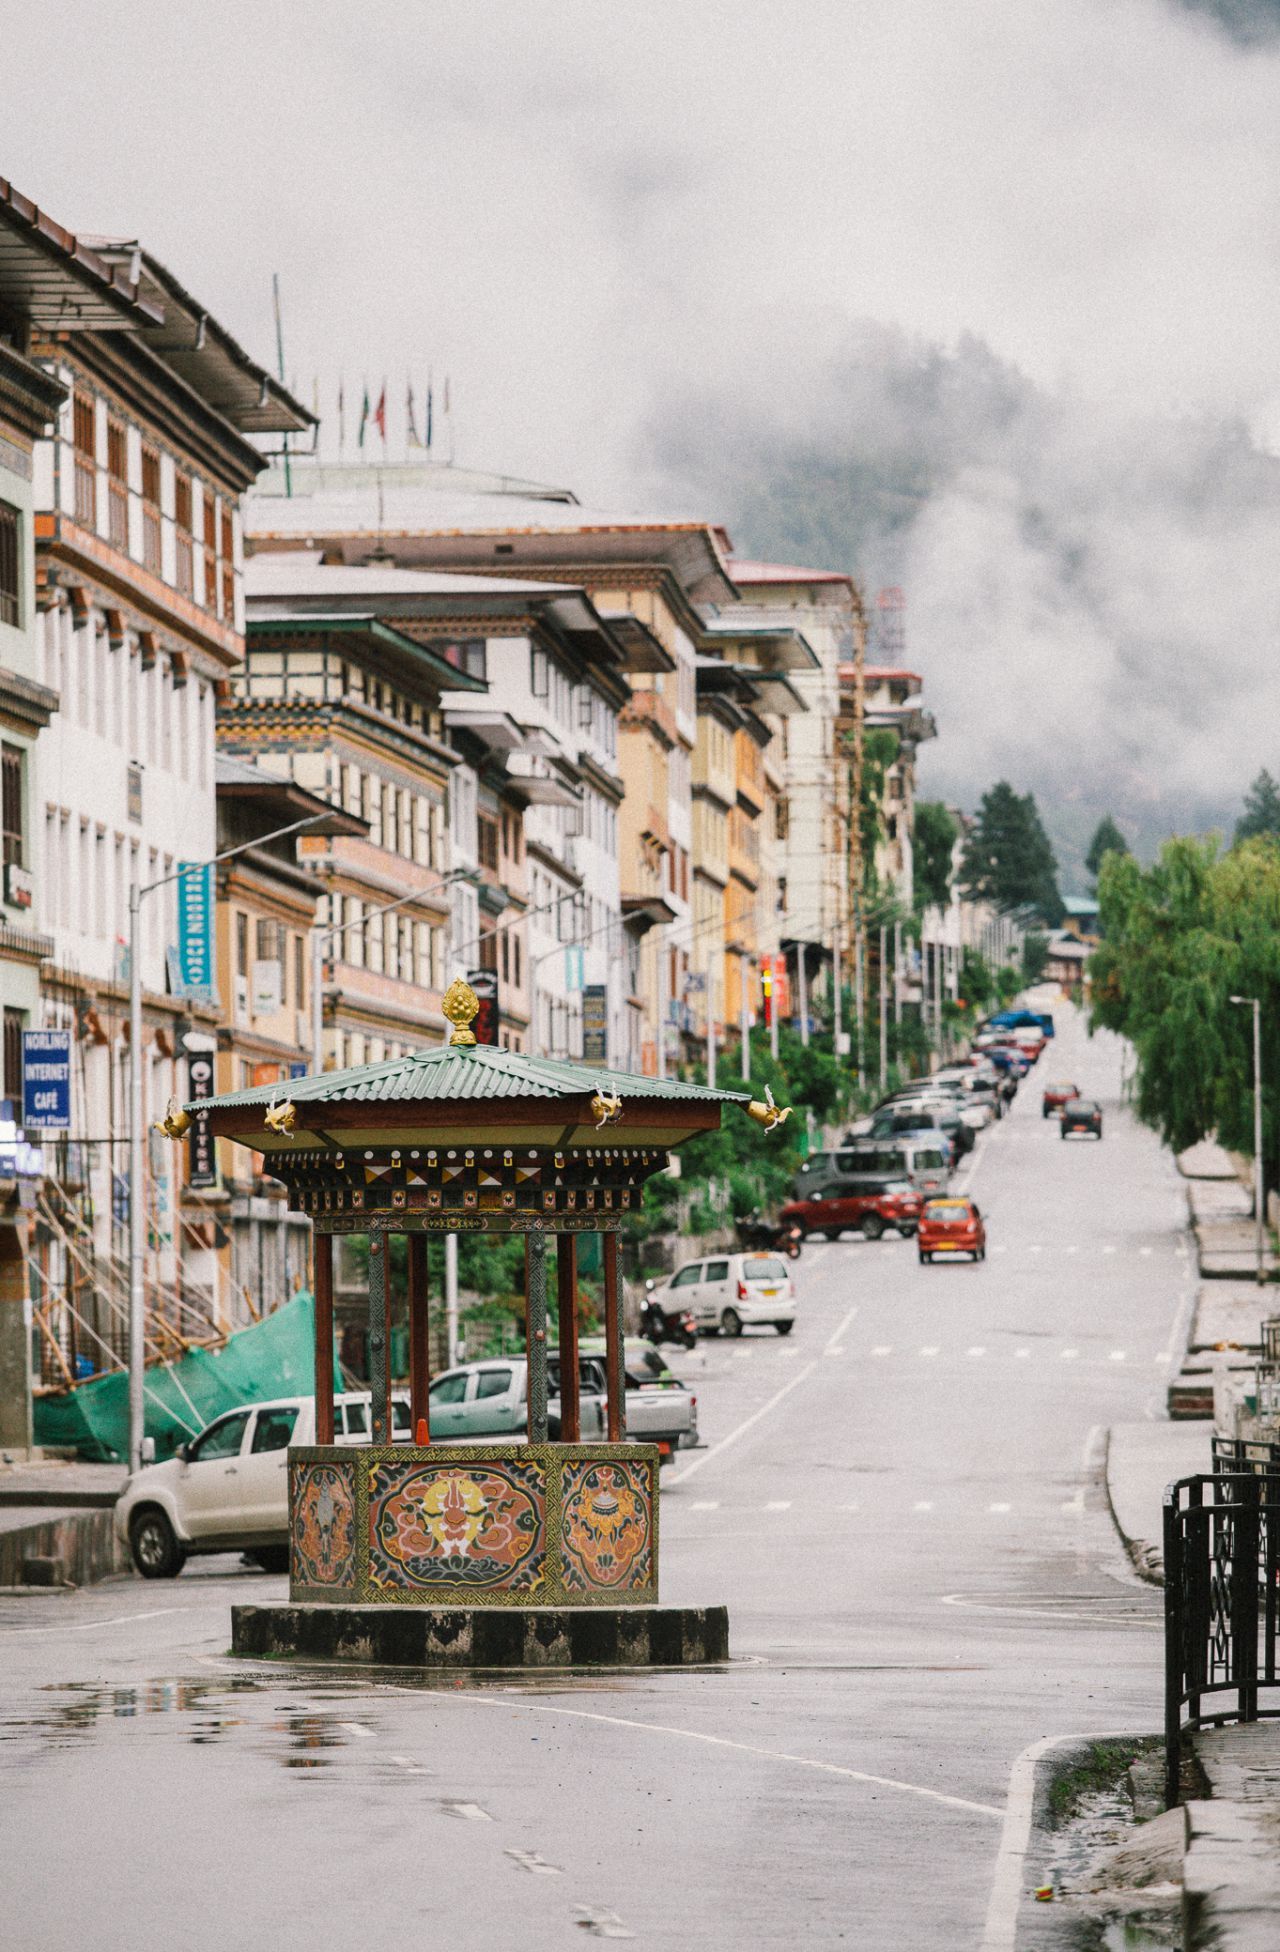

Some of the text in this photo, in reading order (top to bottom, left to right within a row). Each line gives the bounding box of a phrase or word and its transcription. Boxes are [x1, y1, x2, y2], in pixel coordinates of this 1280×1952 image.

[25, 1033, 68, 1050] NORLING
[25, 1063, 69, 1081] INTERNET
[34, 1087, 59, 1110] CAFÉ
[26, 1114, 69, 1125] First Floor
